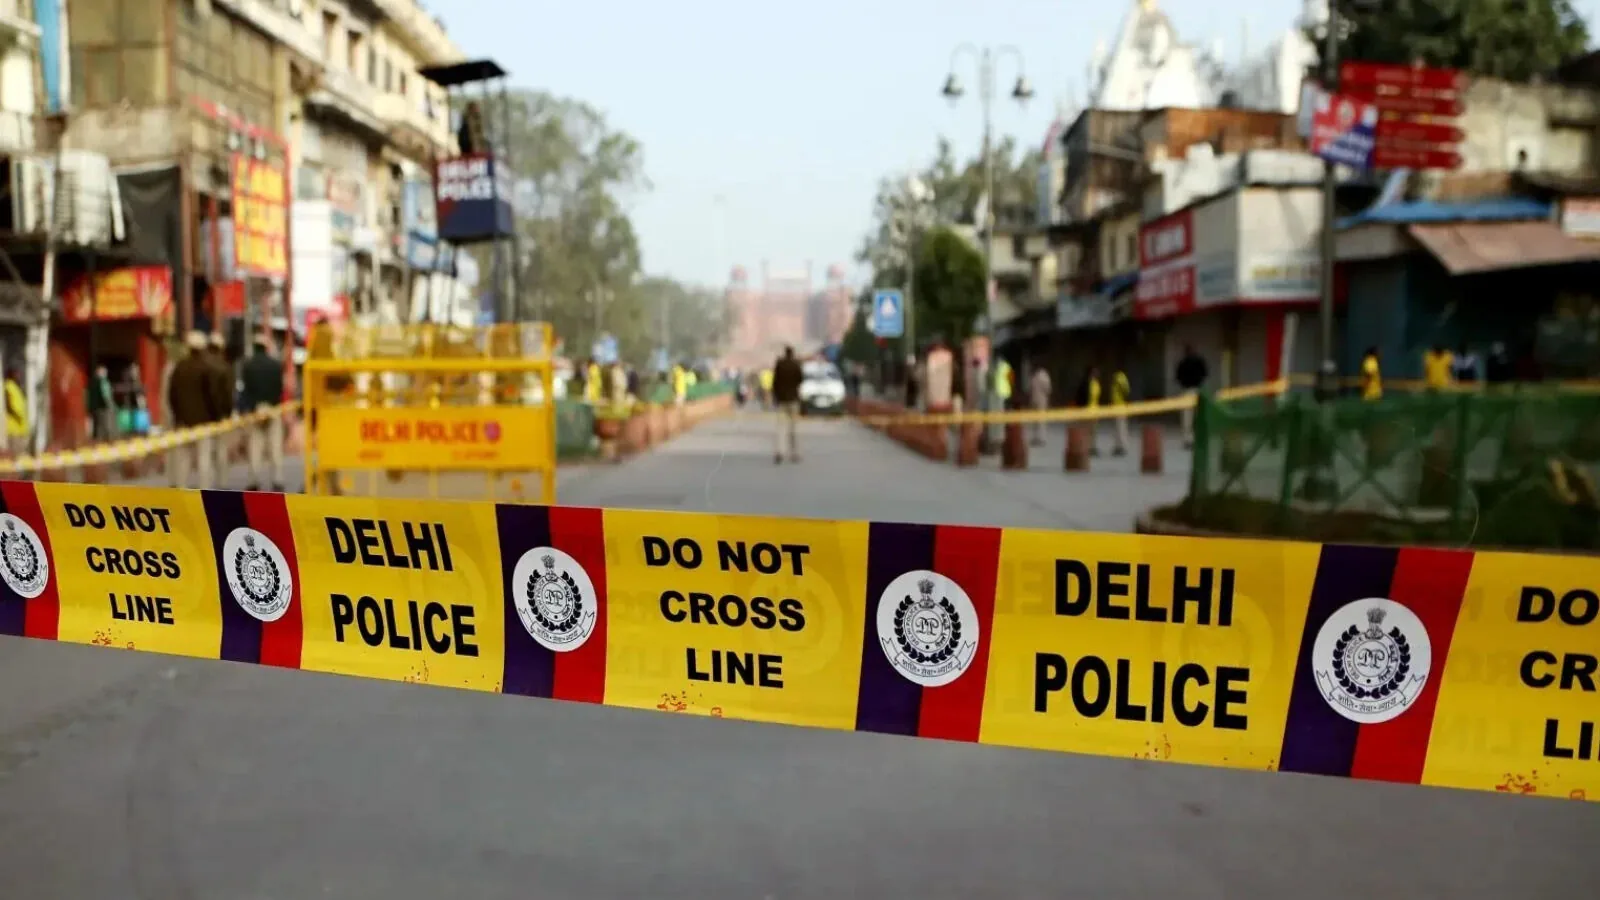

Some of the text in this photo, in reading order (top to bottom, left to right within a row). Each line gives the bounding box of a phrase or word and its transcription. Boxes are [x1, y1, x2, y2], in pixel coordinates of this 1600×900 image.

[64, 503, 171, 533] DO NOT
[86, 546, 181, 579] CROSS
[325, 517, 453, 572] DELHI
[643, 536, 810, 576] DO NOT
[109, 592, 174, 625] LINE
[659, 590, 806, 632] CROSS
[1055, 559, 1236, 627] DELHI
[1516, 586, 1600, 626] DO
[331, 593, 479, 657] POLICE
[686, 647, 784, 689] LINE
[1034, 652, 1250, 731] POLICE
[1543, 718, 1600, 760] LI
